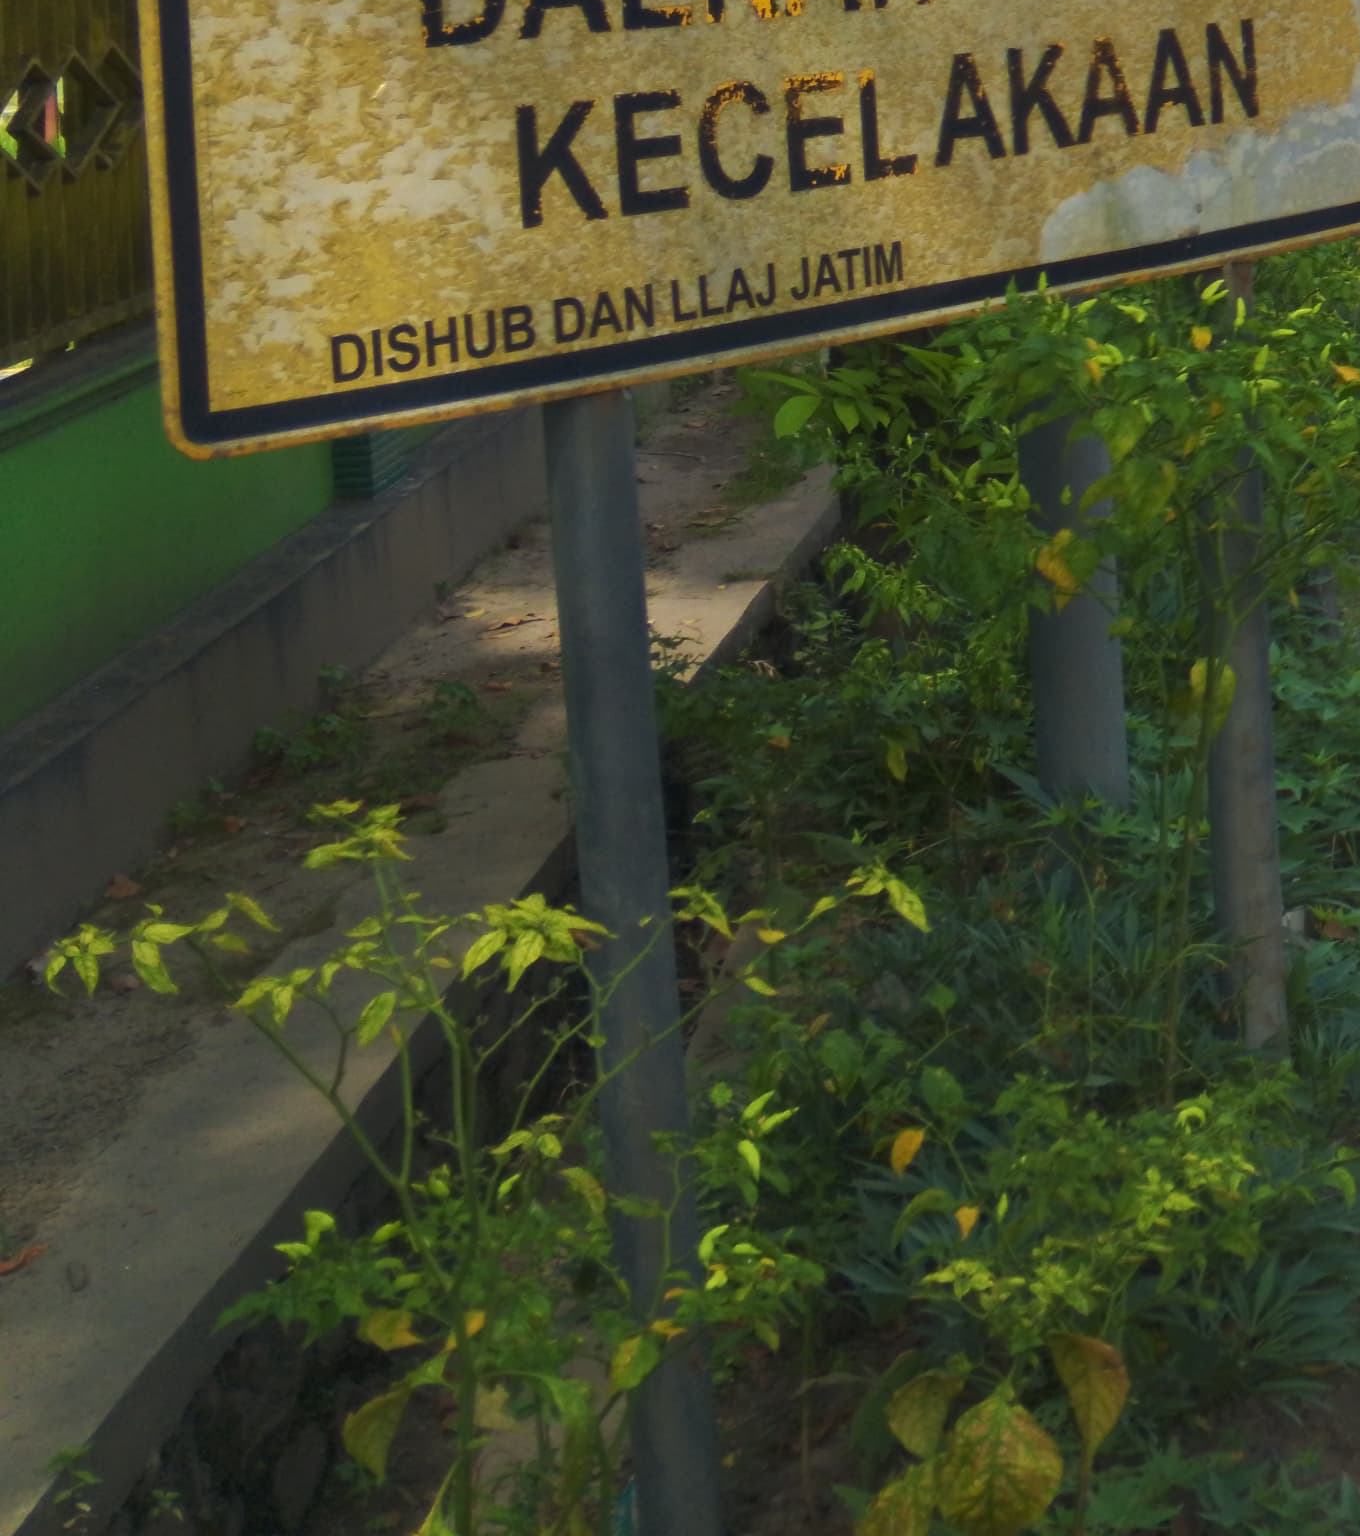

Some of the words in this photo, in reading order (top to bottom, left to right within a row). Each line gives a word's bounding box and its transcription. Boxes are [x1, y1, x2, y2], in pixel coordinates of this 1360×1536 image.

[515, 18, 1260, 230] KECELAKAAN
[331, 304, 542, 383] DISHUB
[553, 282, 663, 355] DAN
[671, 263, 784, 324] LLAJ
[791, 241, 903, 301] JATIM
